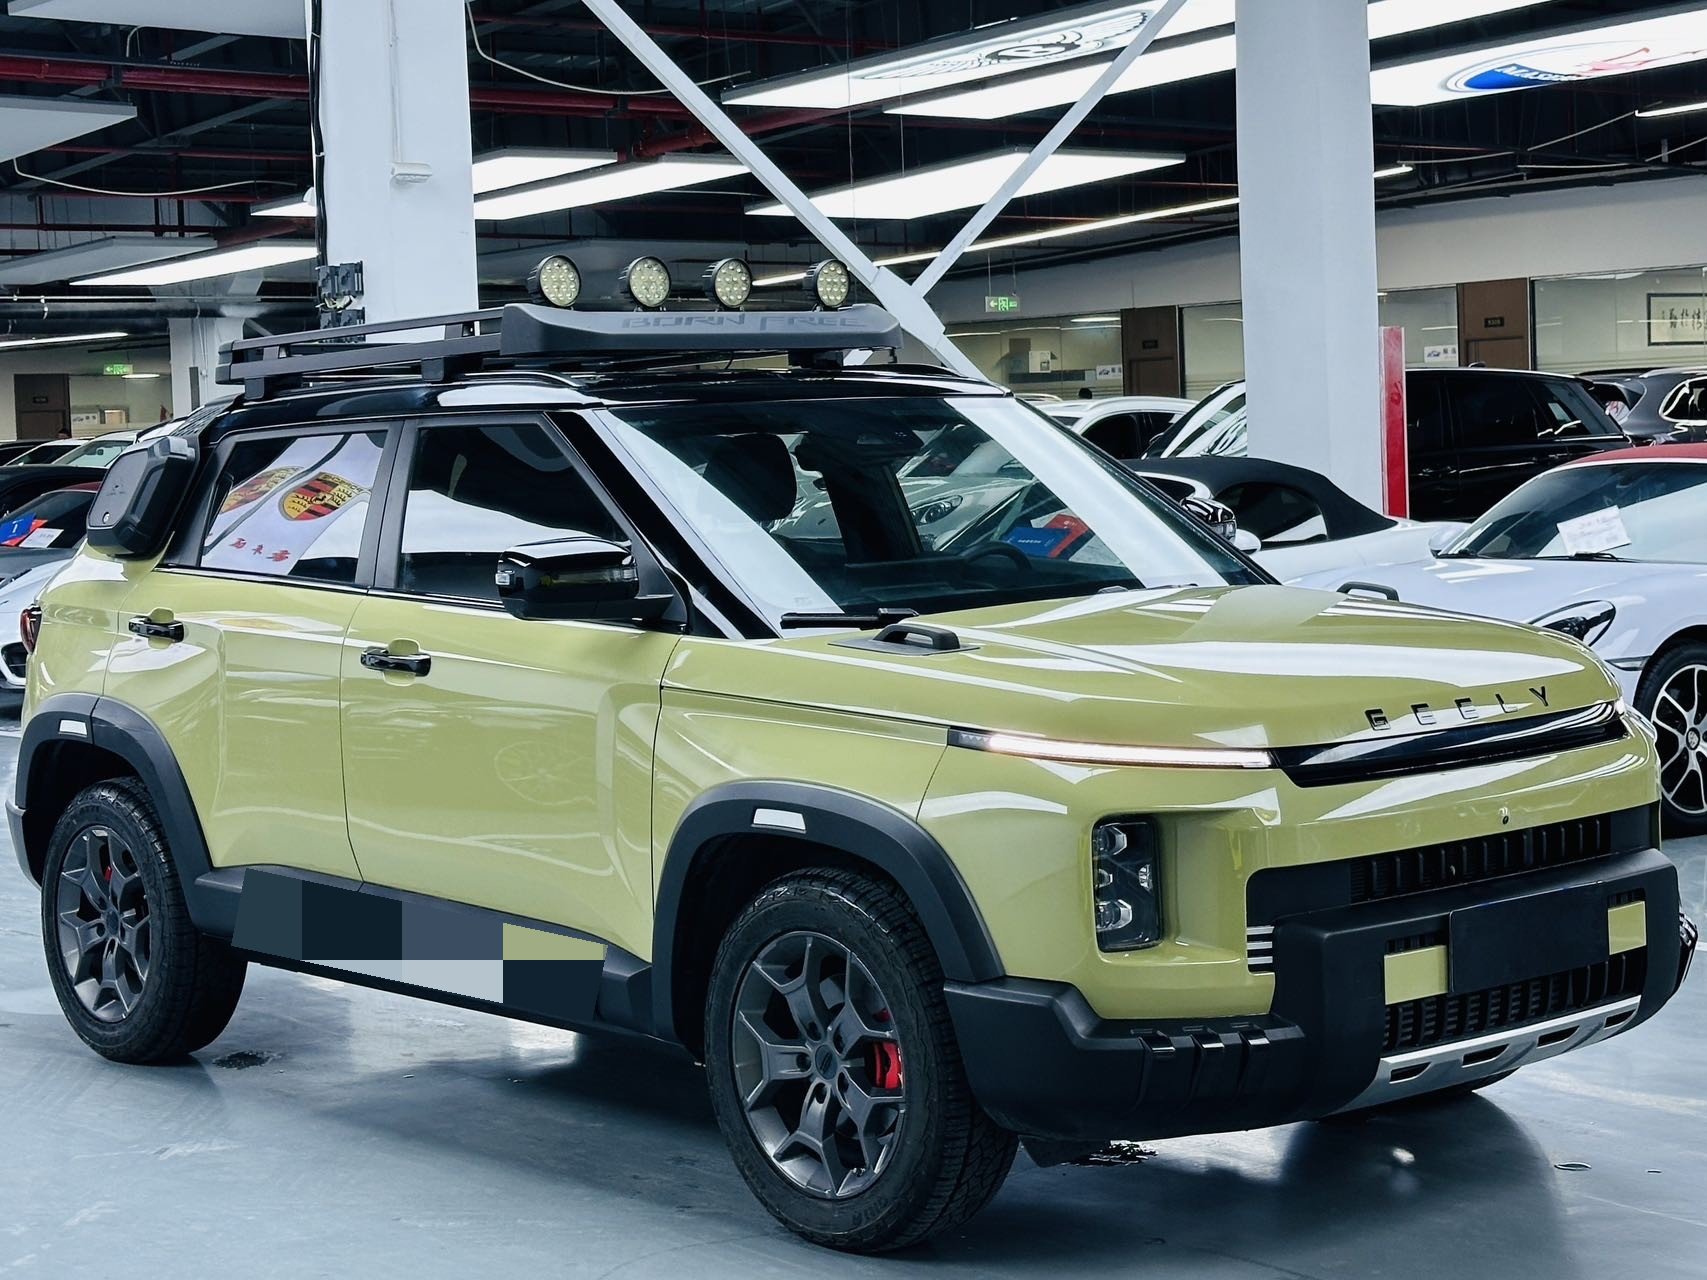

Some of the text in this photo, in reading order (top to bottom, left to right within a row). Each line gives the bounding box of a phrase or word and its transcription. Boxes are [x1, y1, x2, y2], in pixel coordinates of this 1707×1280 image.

[622, 313, 868, 331] BORN FREE
[1364, 686, 1549, 731] GEELY
